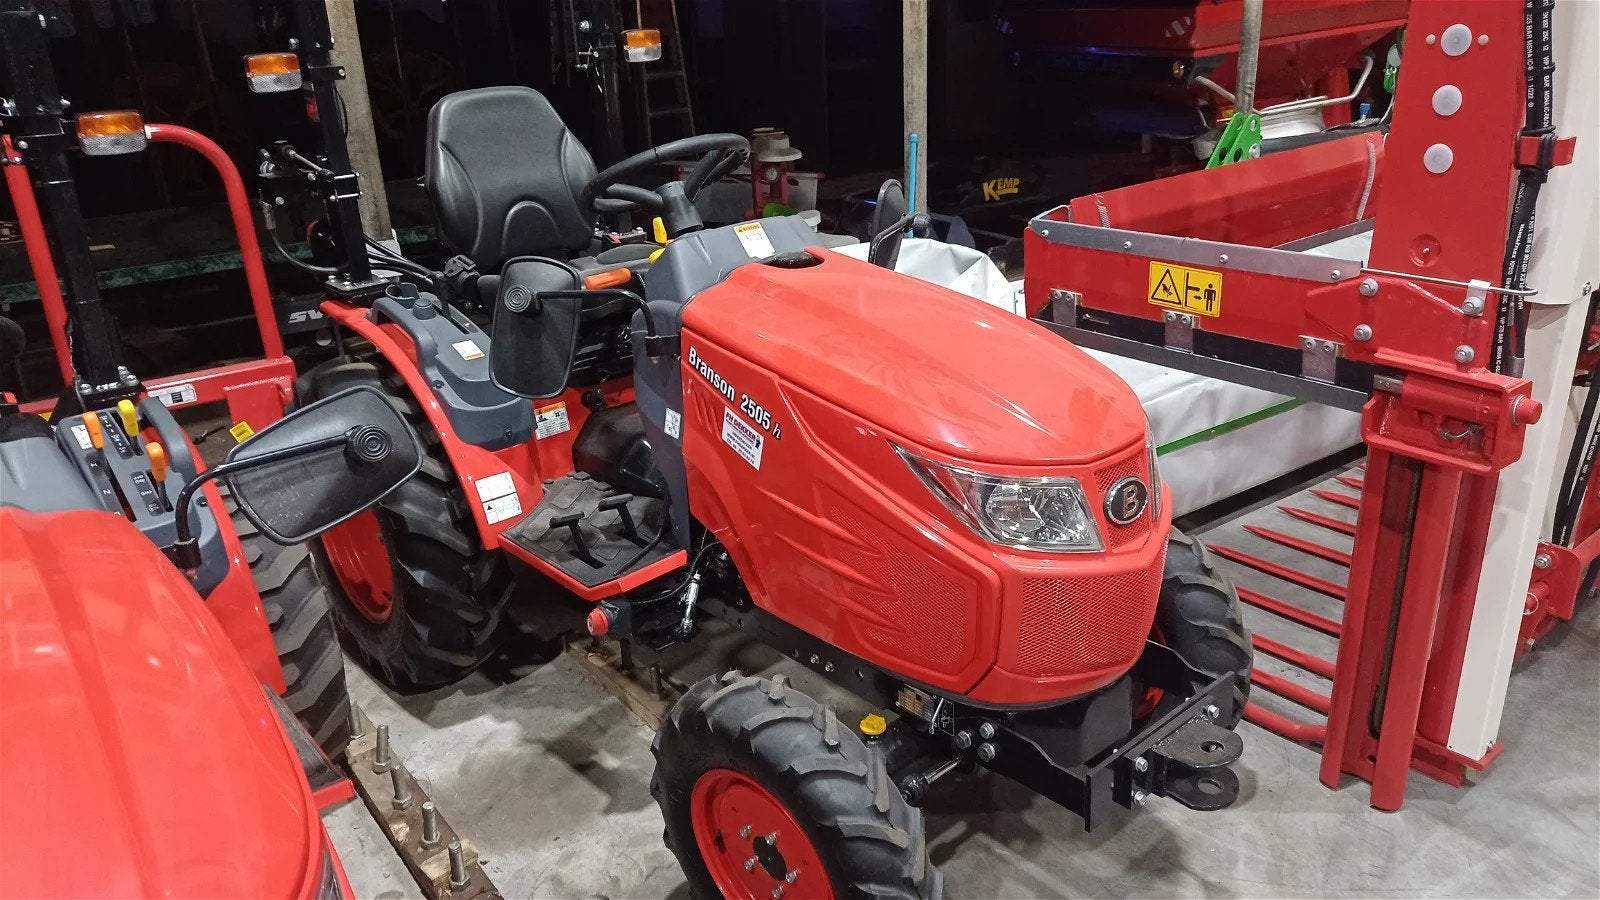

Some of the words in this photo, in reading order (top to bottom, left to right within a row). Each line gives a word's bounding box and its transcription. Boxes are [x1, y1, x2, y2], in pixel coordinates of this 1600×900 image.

[688, 346, 736, 402] Branson
[740, 394, 771, 430] 2505
[734, 420, 756, 440] DEKKER
[1122, 484, 1138, 518] B
